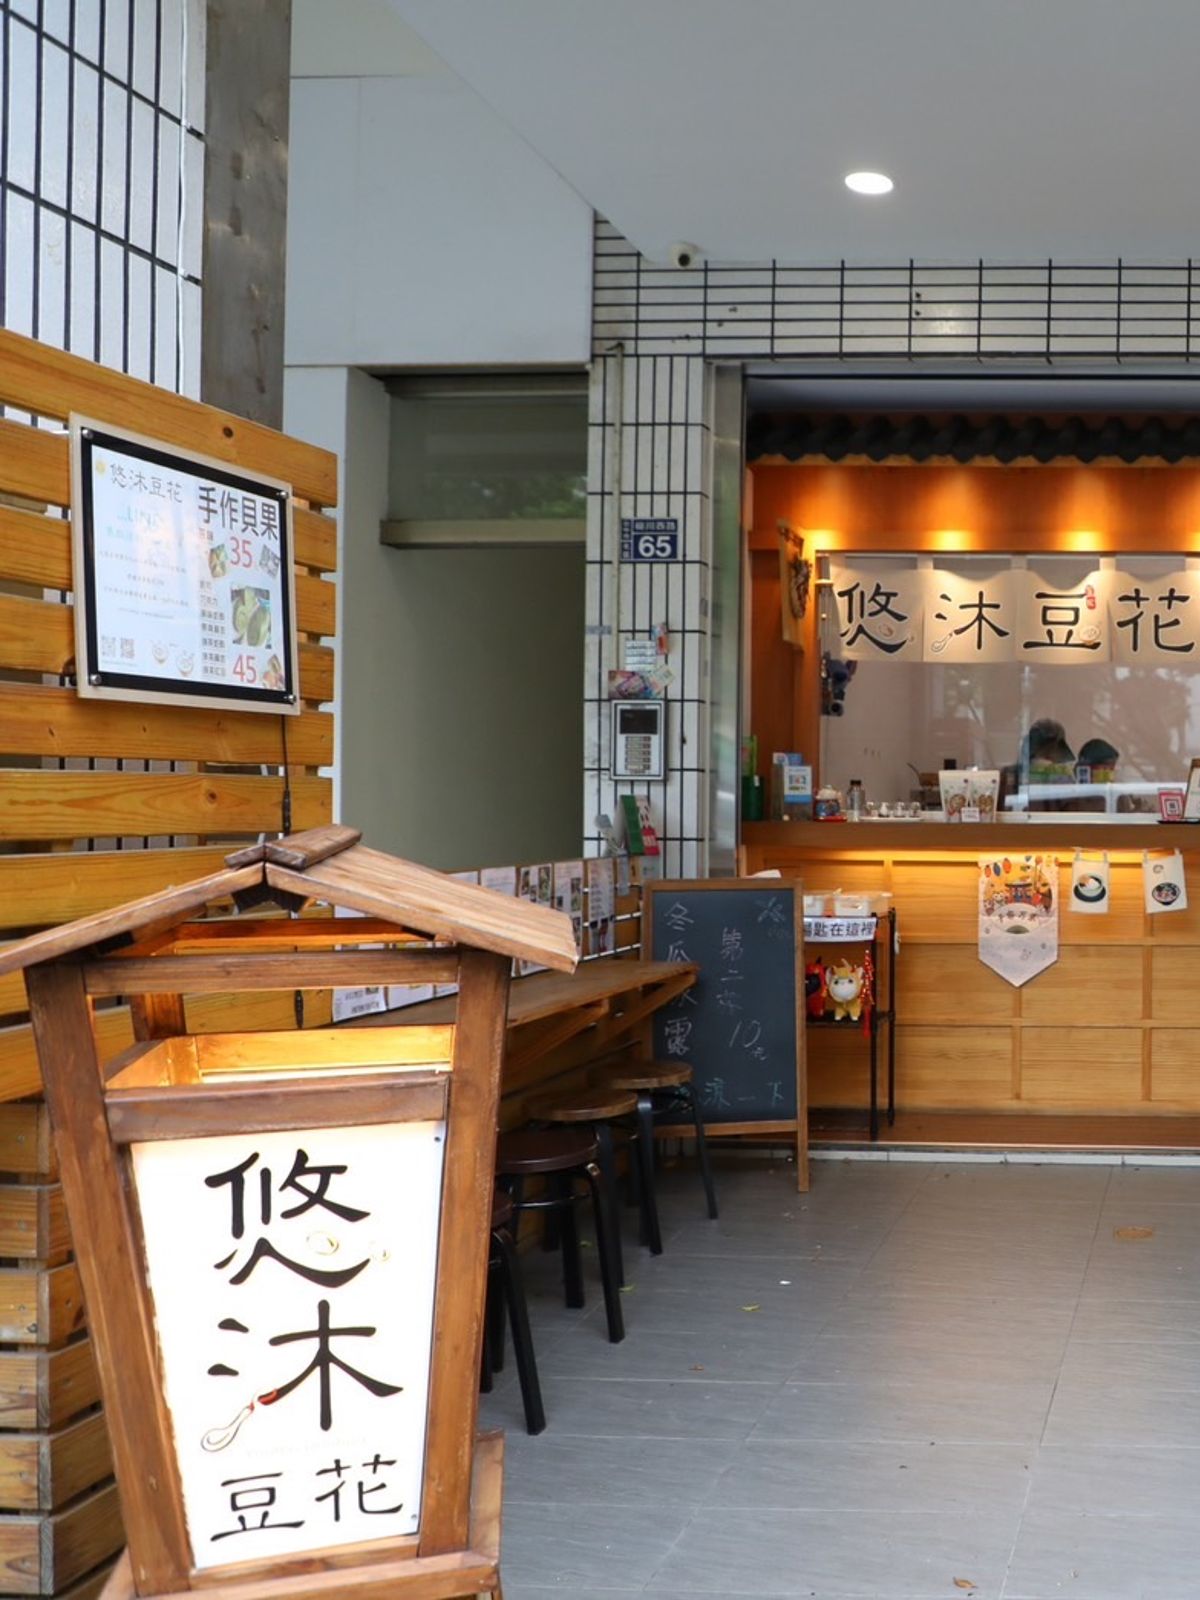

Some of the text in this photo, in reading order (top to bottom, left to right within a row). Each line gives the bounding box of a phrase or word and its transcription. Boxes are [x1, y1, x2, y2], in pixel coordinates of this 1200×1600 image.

[110, 462, 183, 504] 悠沐豆花
[198, 485, 279, 541] 手作貝果
[230, 536, 254, 569] 35
[638, 535, 673, 558] 65
[837, 581, 1197, 654] 悠沐豆花
[232, 654, 258, 685] 45
[204, 1147, 404, 1433] 悠沐
[210, 1453, 404, 1542] 豆花
